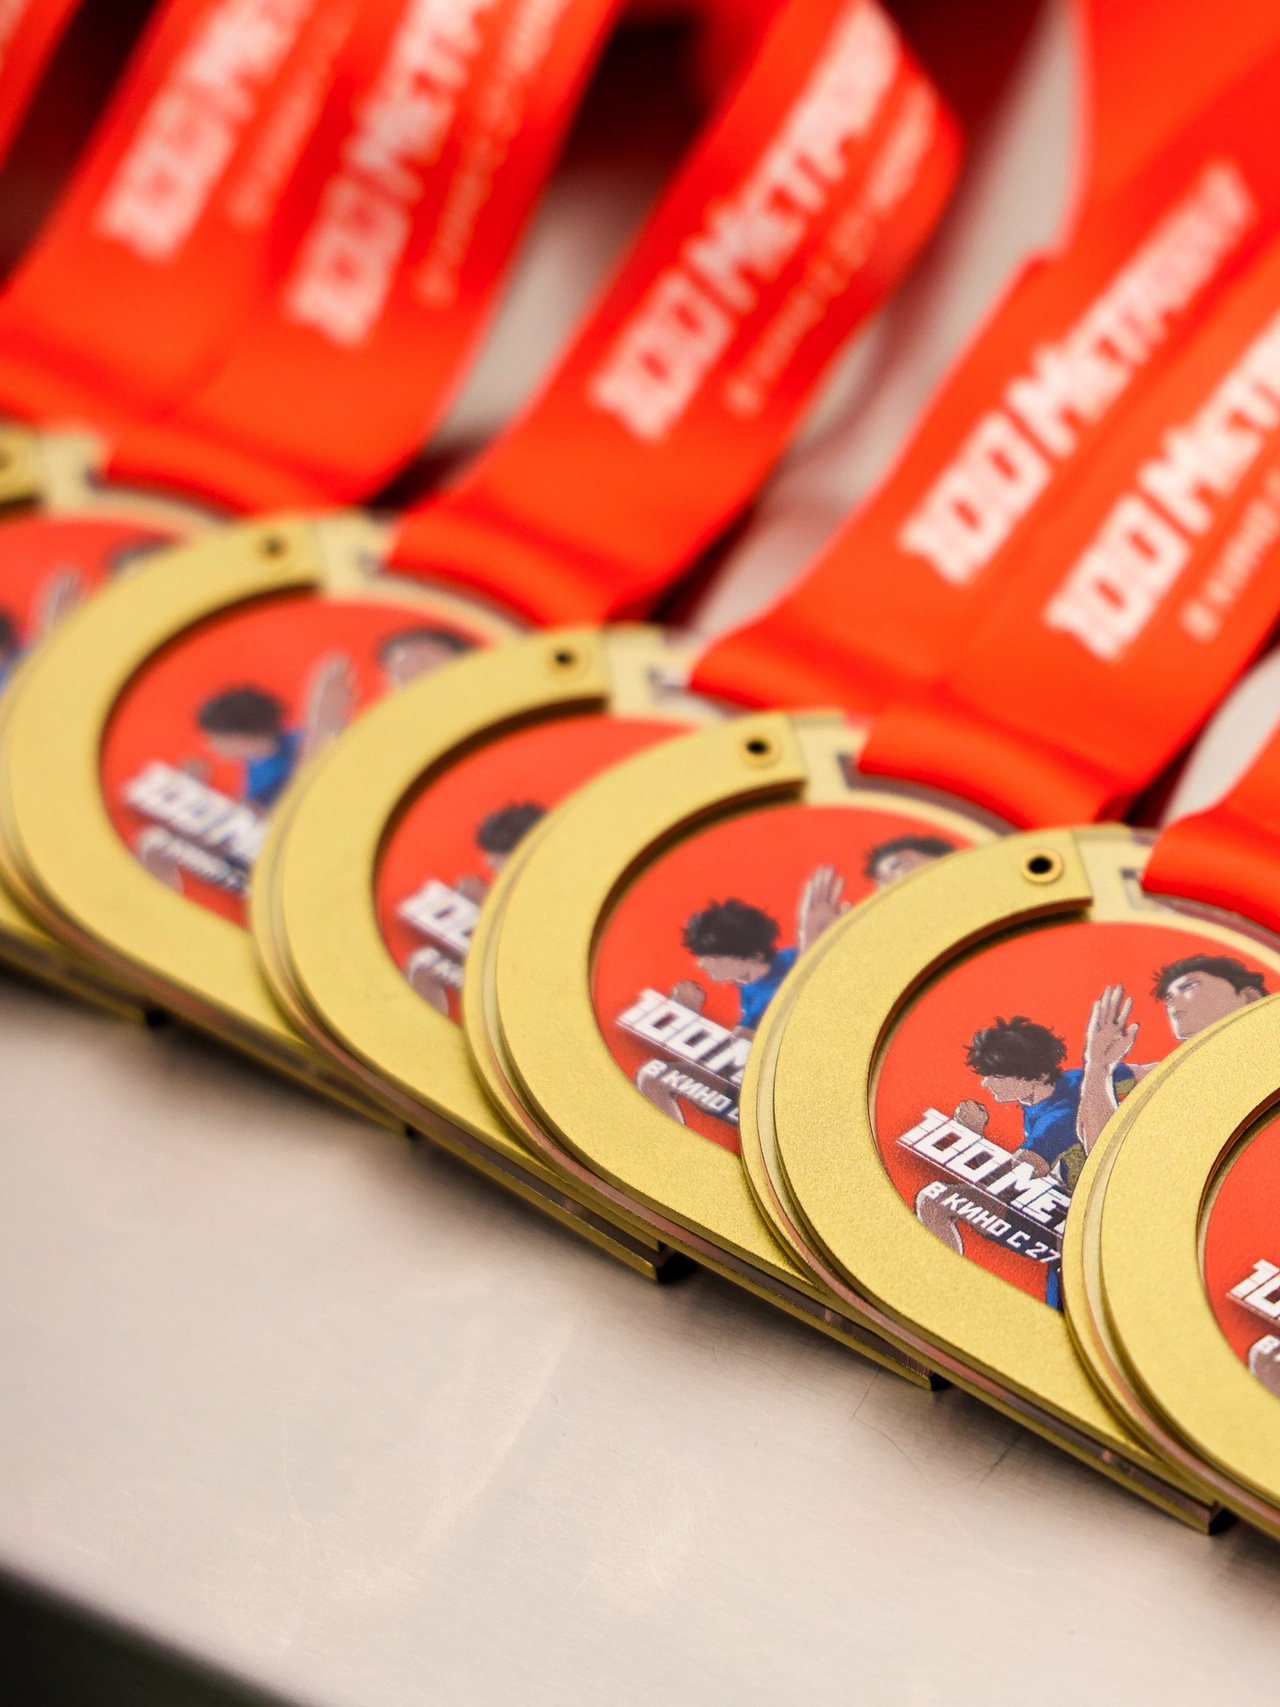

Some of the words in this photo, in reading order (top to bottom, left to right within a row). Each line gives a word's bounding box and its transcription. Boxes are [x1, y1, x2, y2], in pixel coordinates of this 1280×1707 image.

[898, 410, 1052, 586] 100
[1044, 492, 1192, 660] 100
[616, 987, 737, 1062] 100
[661, 1070, 732, 1113] КИНО
[896, 1107, 1017, 1183] 100
[941, 1192, 1012, 1236] КИНО
[1006, 1230, 1030, 1248] С
[1025, 1241, 1061, 1263] 27
